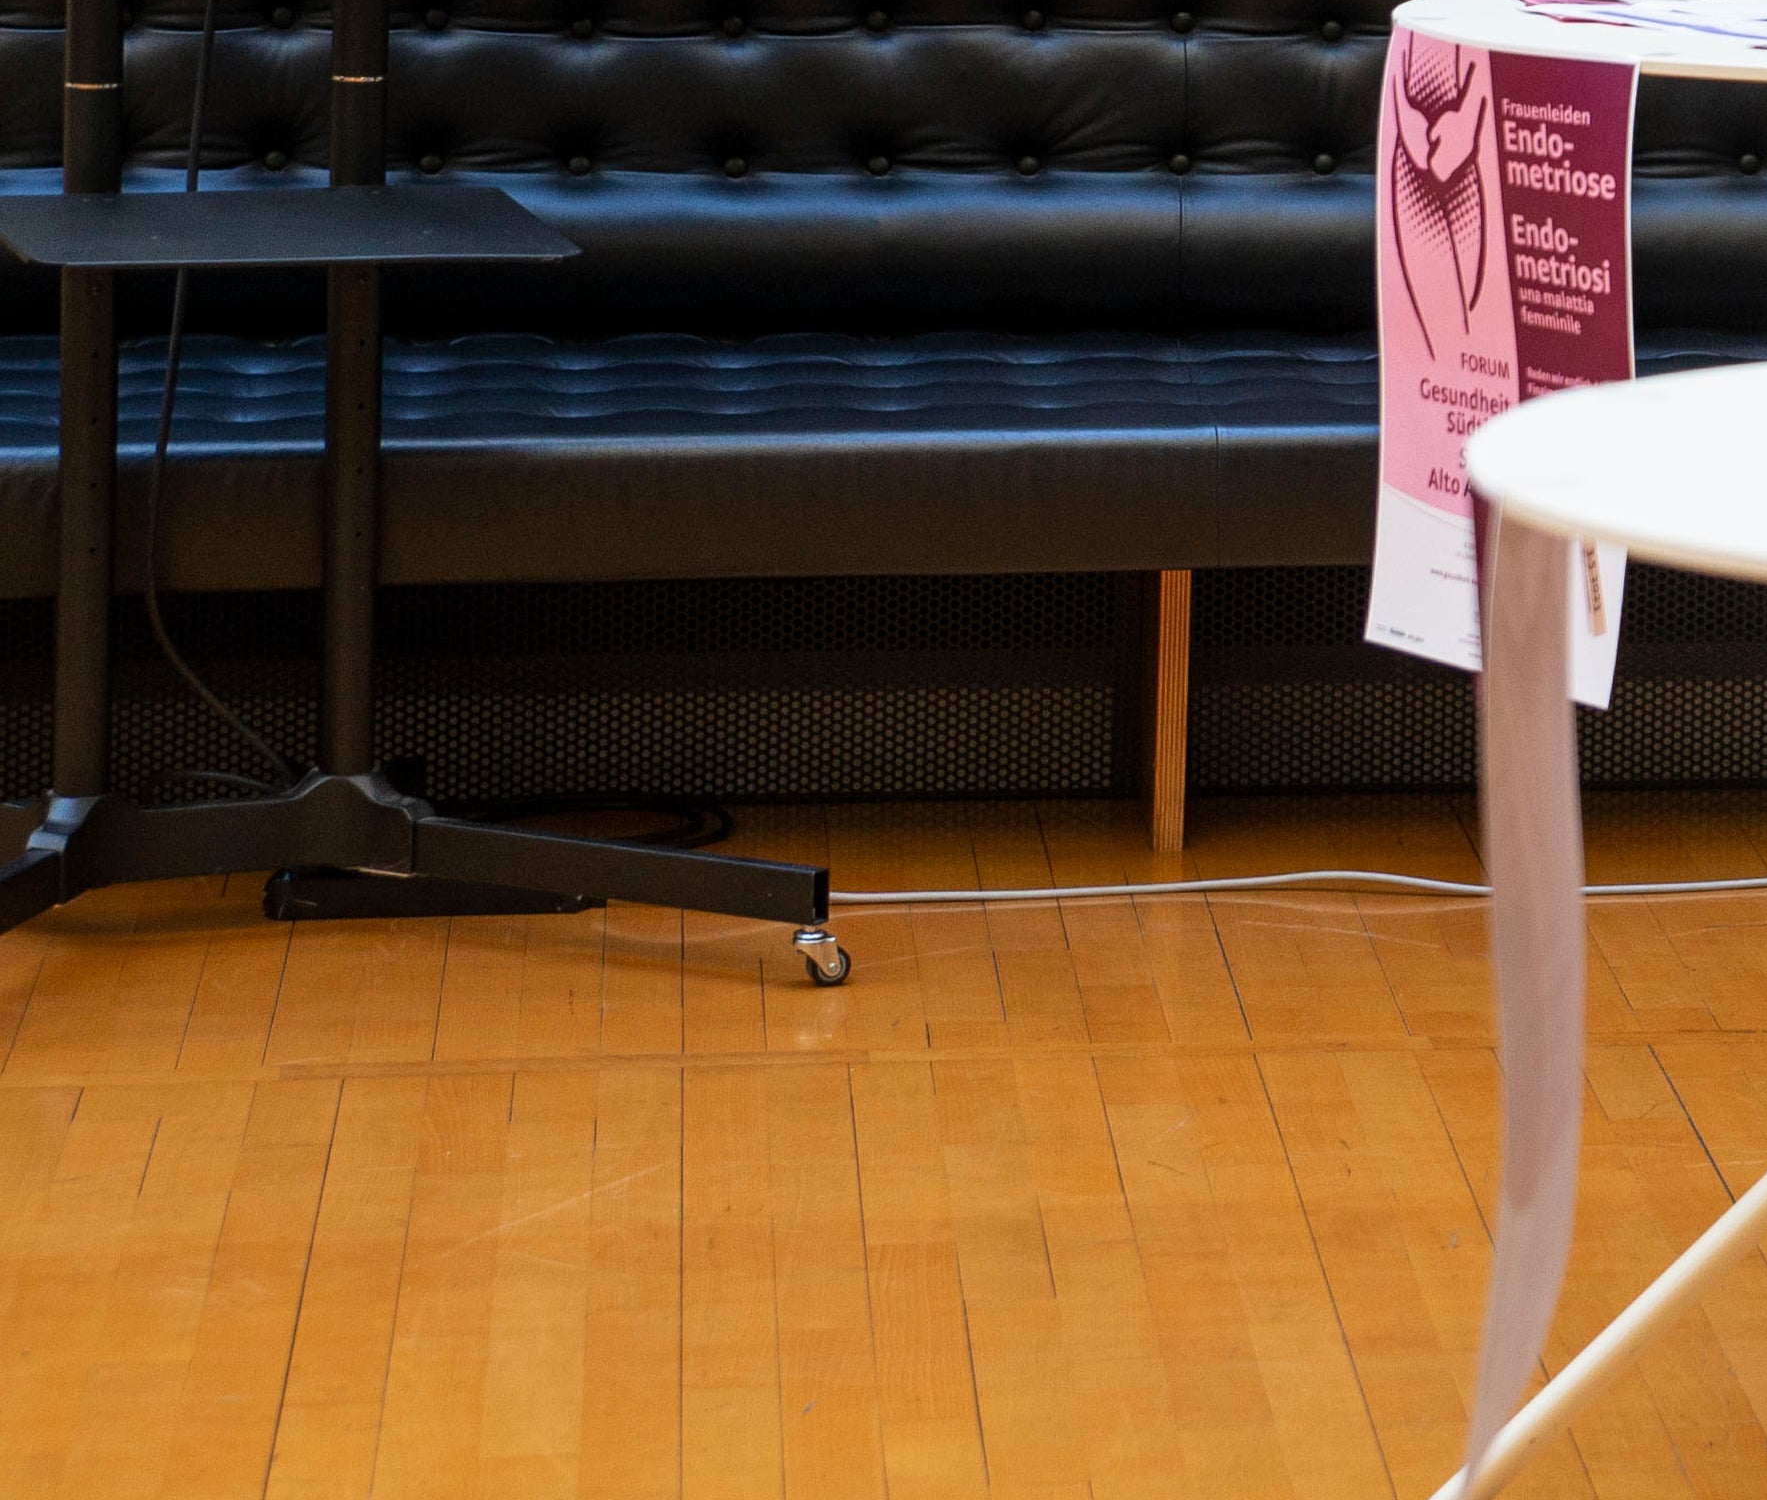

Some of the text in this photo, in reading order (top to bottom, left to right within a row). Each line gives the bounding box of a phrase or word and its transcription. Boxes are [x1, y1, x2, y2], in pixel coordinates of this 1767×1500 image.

[1501, 97, 1591, 126] Frauenleiden
[1503, 120, 1575, 159] Endo-
[1507, 160, 1617, 201] metriose
[1511, 213, 1579, 254] Endo-
[1515, 254, 1612, 295] metriosi
[1520, 305, 1582, 335] femminile
[1461, 352, 1511, 379] FORUM
[1420, 377, 1510, 415] Gesundheit
[1428, 467, 1460, 495] Alto
